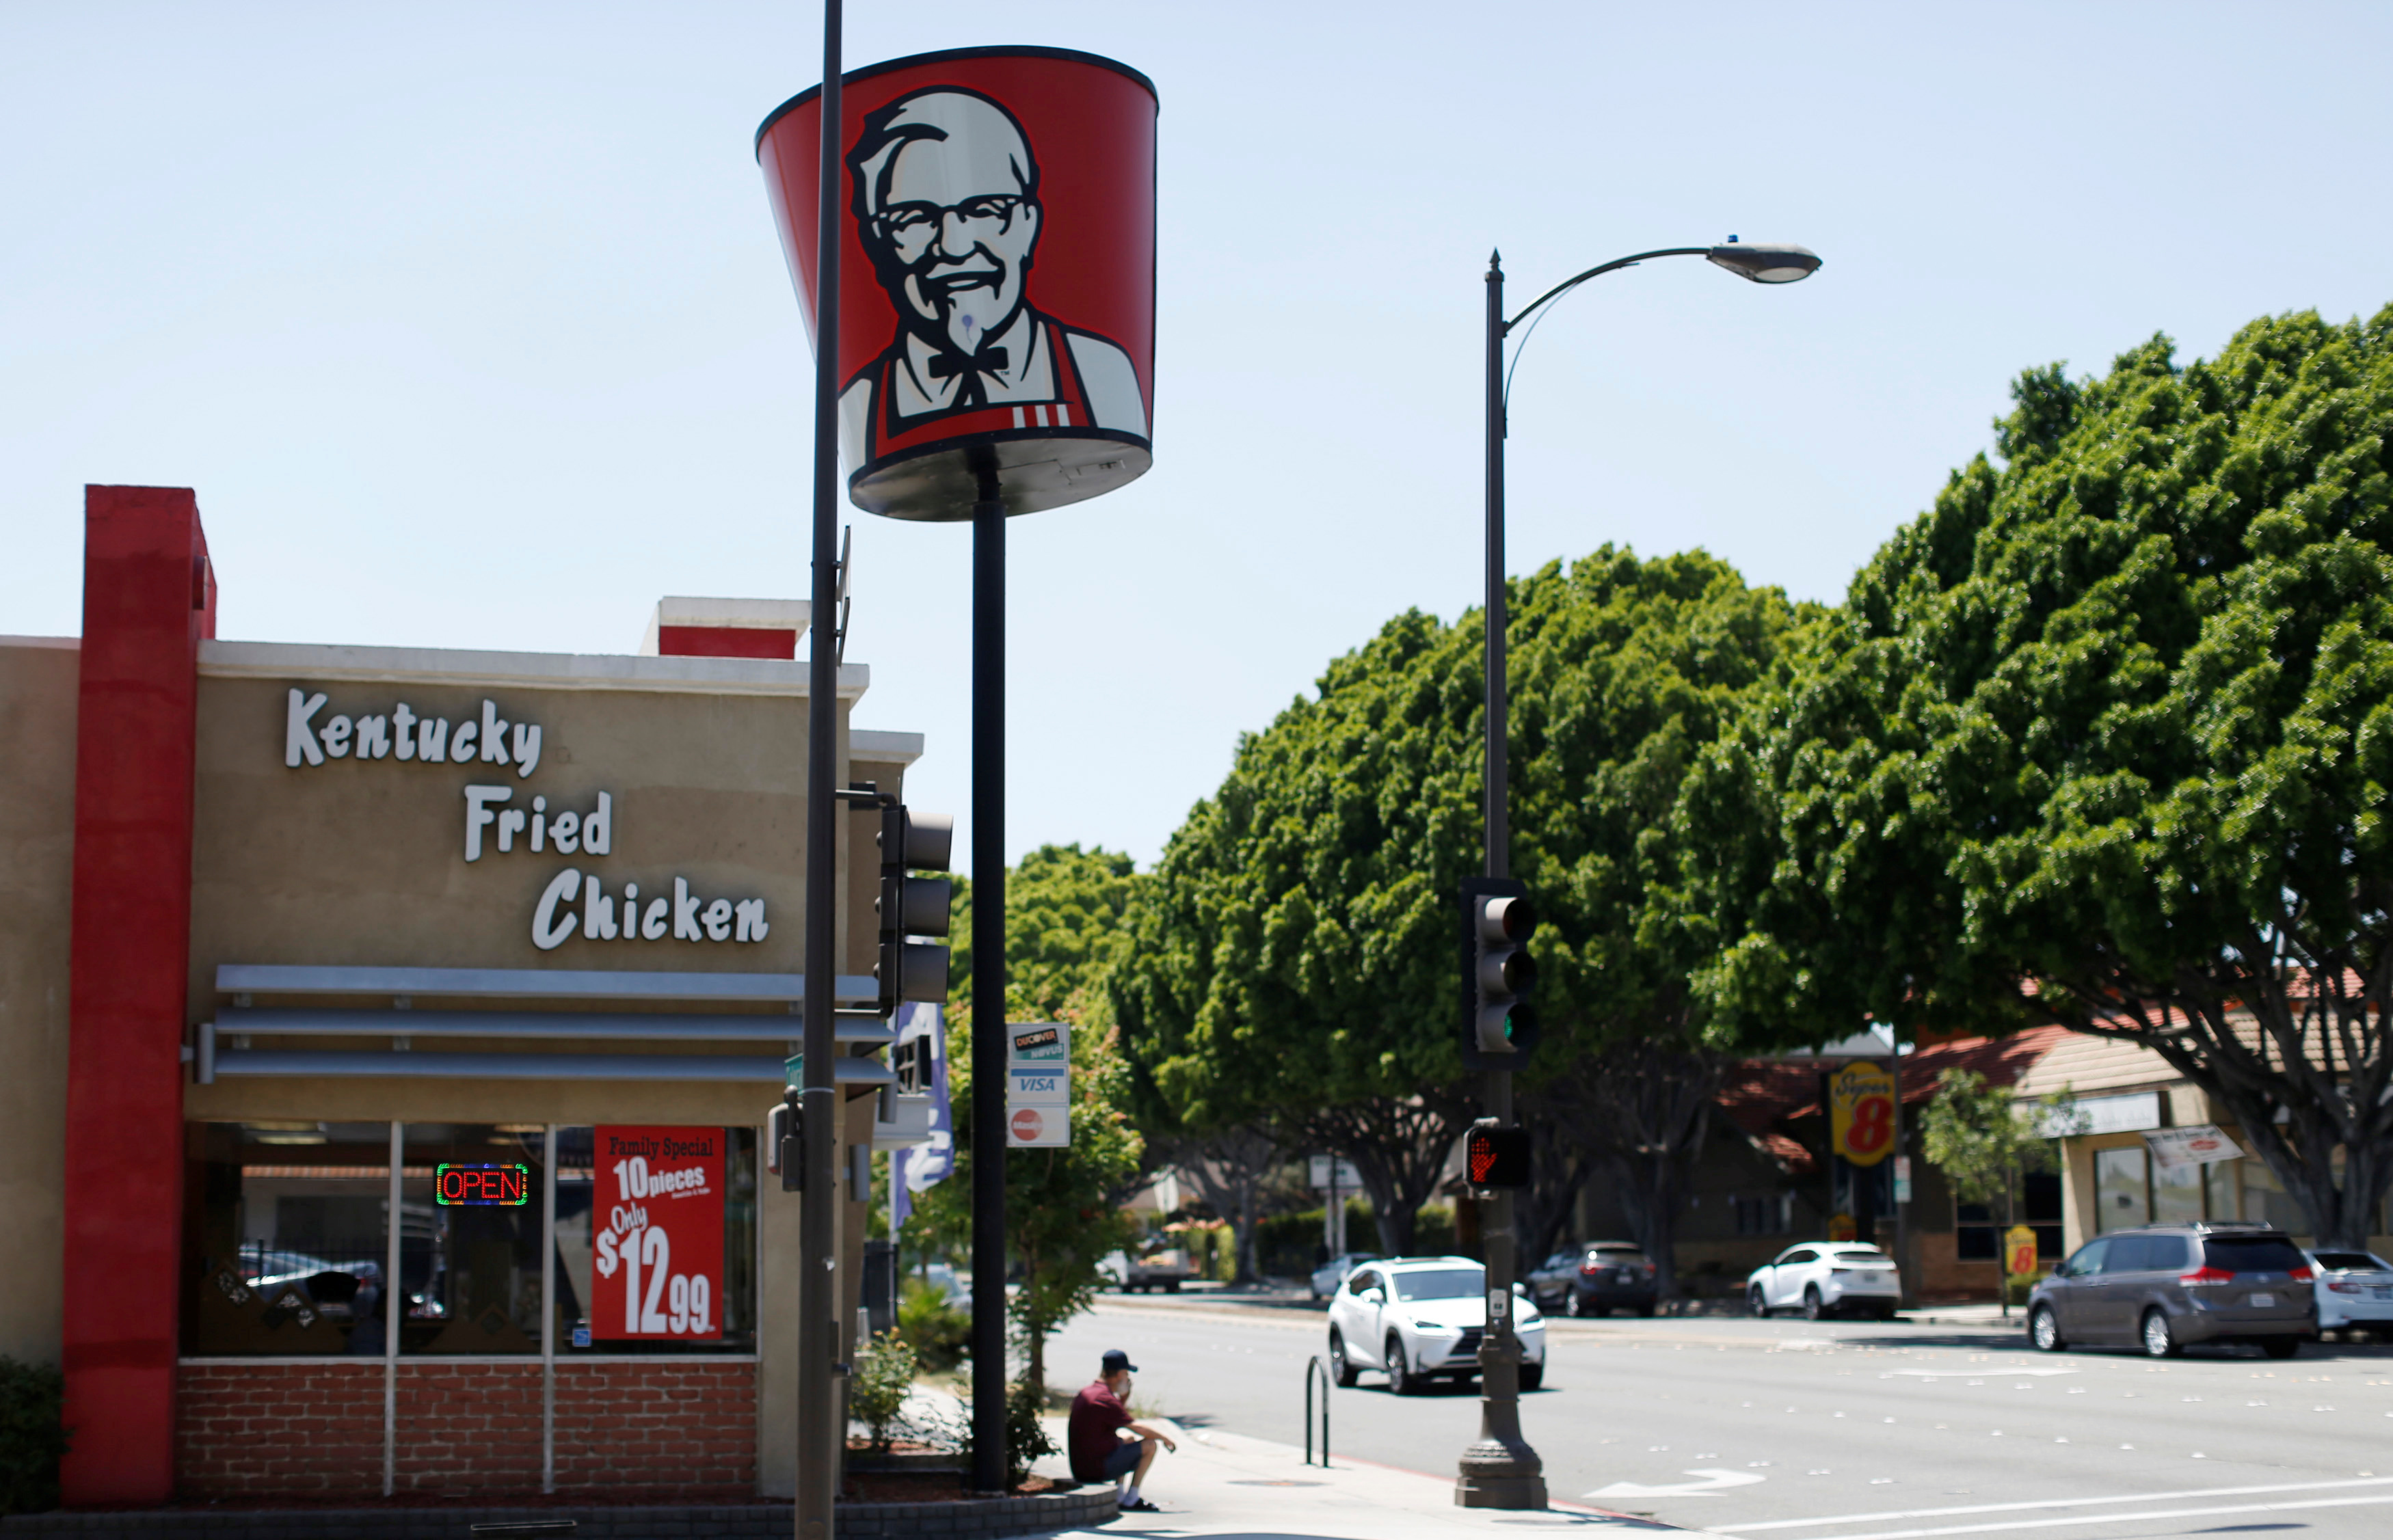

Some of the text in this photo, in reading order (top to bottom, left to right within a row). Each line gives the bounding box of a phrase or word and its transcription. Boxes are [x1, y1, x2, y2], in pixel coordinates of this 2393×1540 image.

[285, 688, 542, 778] Kentucky
[464, 785, 612, 863] Fried
[531, 867, 769, 950] Chicken
[1021, 1078, 1056, 1092] VISA
[1845, 1096, 1893, 1154] 8
[609, 1136, 713, 1161] Family Special
[444, 1172, 520, 1198] OPEN
[613, 1156, 706, 1201] 10 pieces
[611, 1201, 647, 1235] Only
